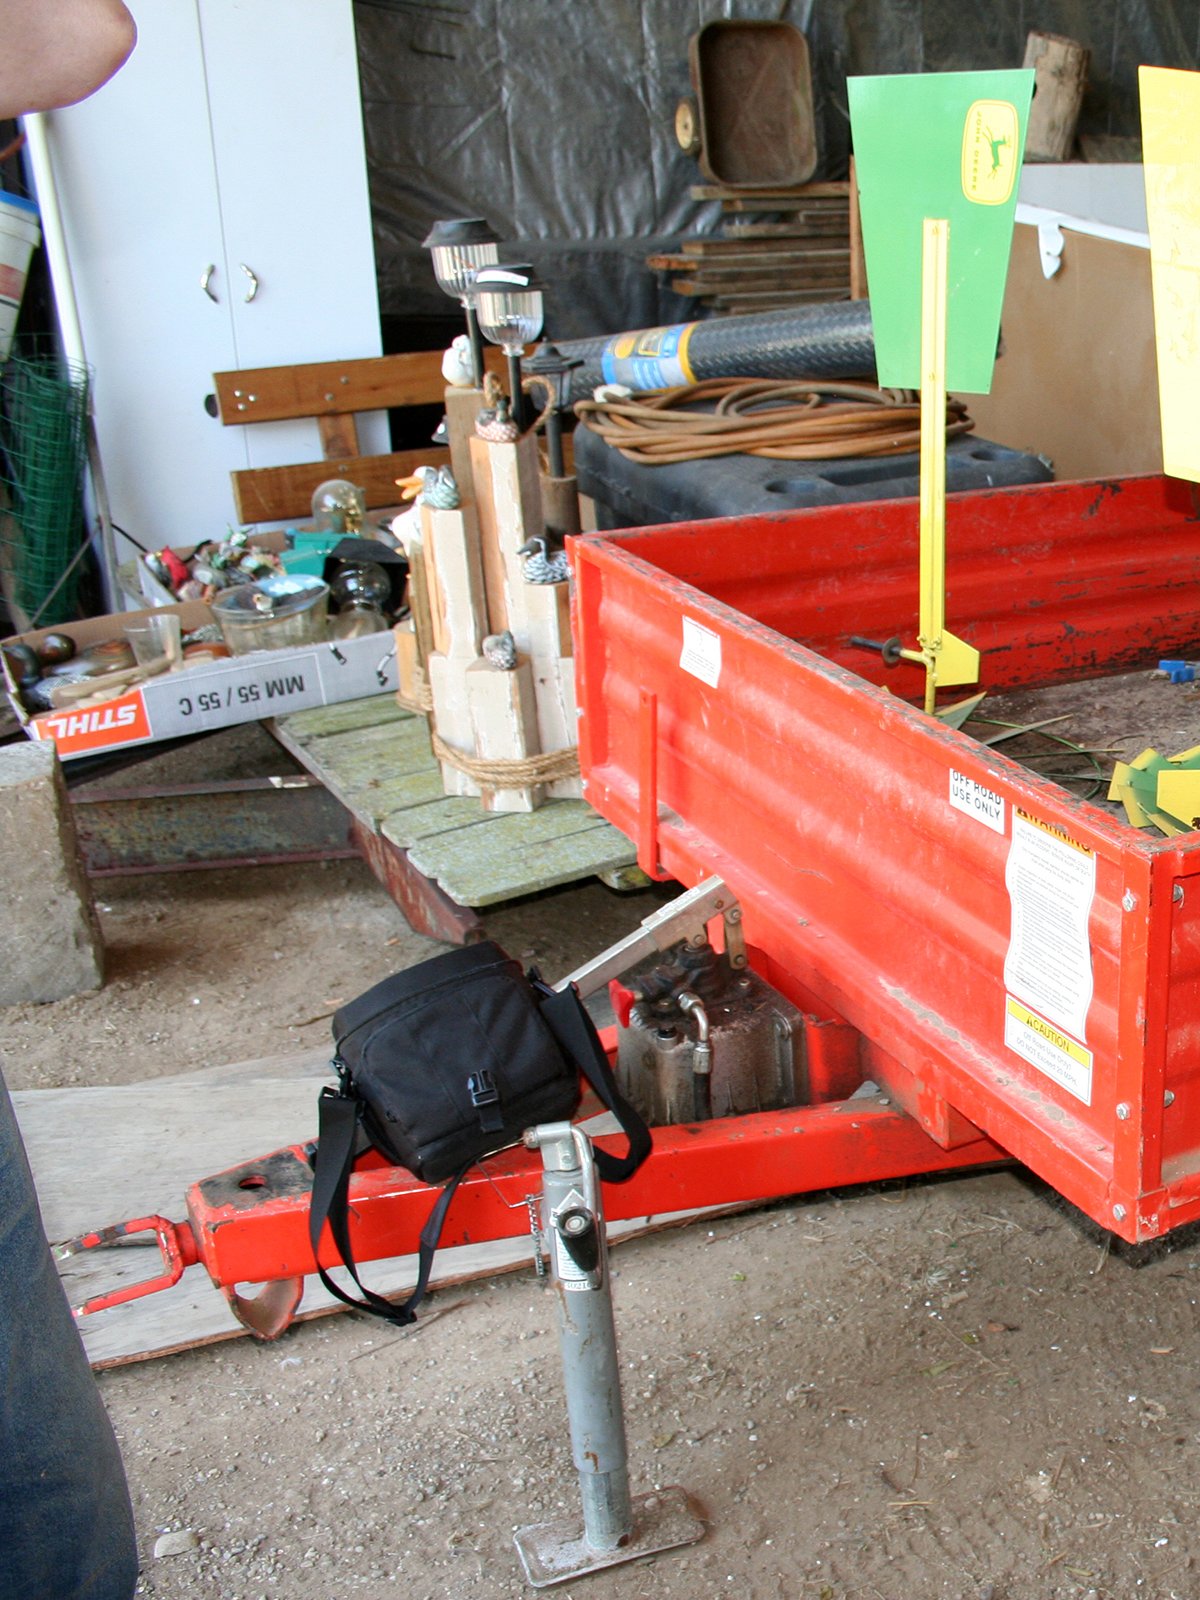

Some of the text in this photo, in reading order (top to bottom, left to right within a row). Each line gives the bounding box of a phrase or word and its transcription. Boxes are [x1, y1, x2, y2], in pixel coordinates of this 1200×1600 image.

[238, 683, 261, 705] 55
[265, 674, 305, 699] MM
[179, 697, 193, 716] C
[198, 690, 222, 712] 55
[48, 703, 138, 739] STIHL
[952, 770, 1002, 806] OFF ROAD
[952, 783, 1000, 821] USE ONLY
[1033, 1019, 1070, 1053] CAUTION
[1025, 1042, 1036, 1056] NOT
